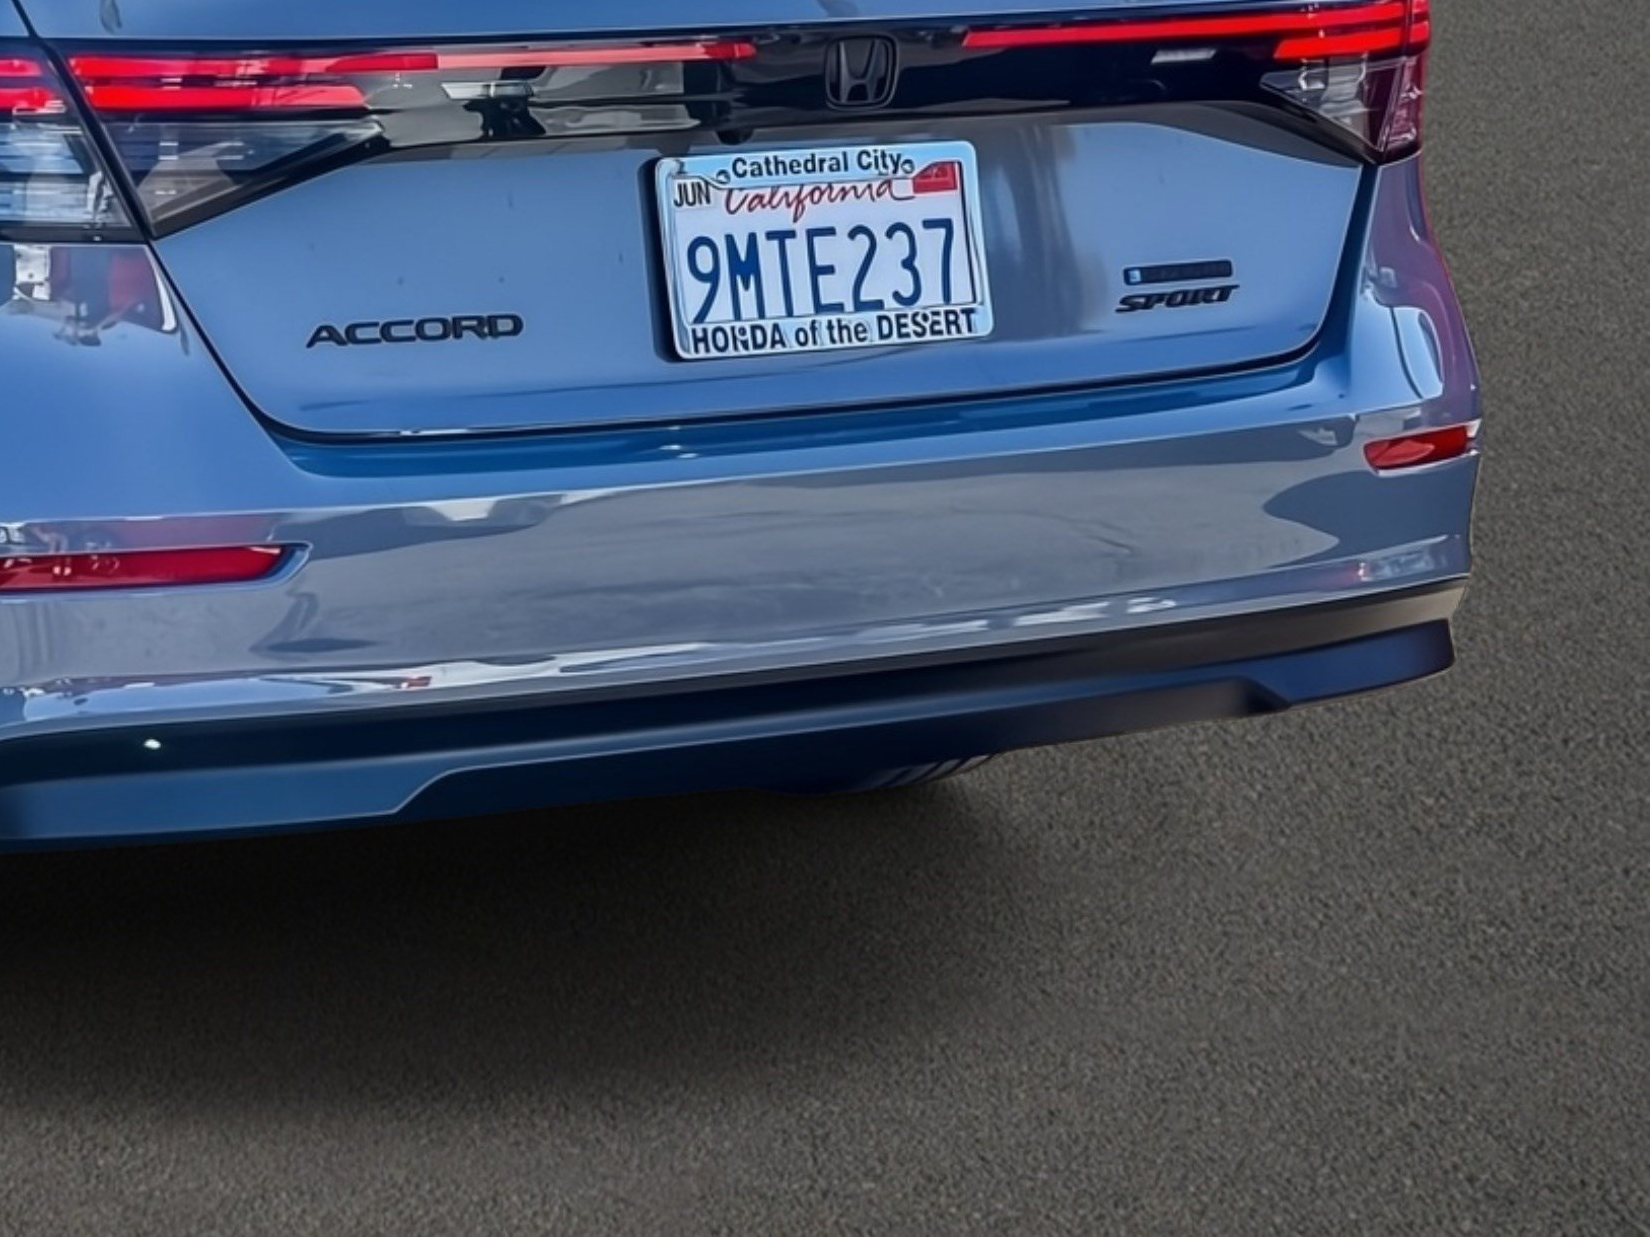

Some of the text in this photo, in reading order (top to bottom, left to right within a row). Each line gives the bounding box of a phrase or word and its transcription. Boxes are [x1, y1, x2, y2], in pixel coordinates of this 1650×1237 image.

[731, 150, 849, 179] Cathedral
[856, 148, 902, 175] City
[673, 180, 712, 208] JUN
[724, 177, 915, 223] California
[686, 217, 954, 325] 9MTE237
[1115, 284, 1240, 314] SPORT
[305, 313, 524, 349] ACCORD
[691, 307, 978, 355] HONDA of the DESERT
